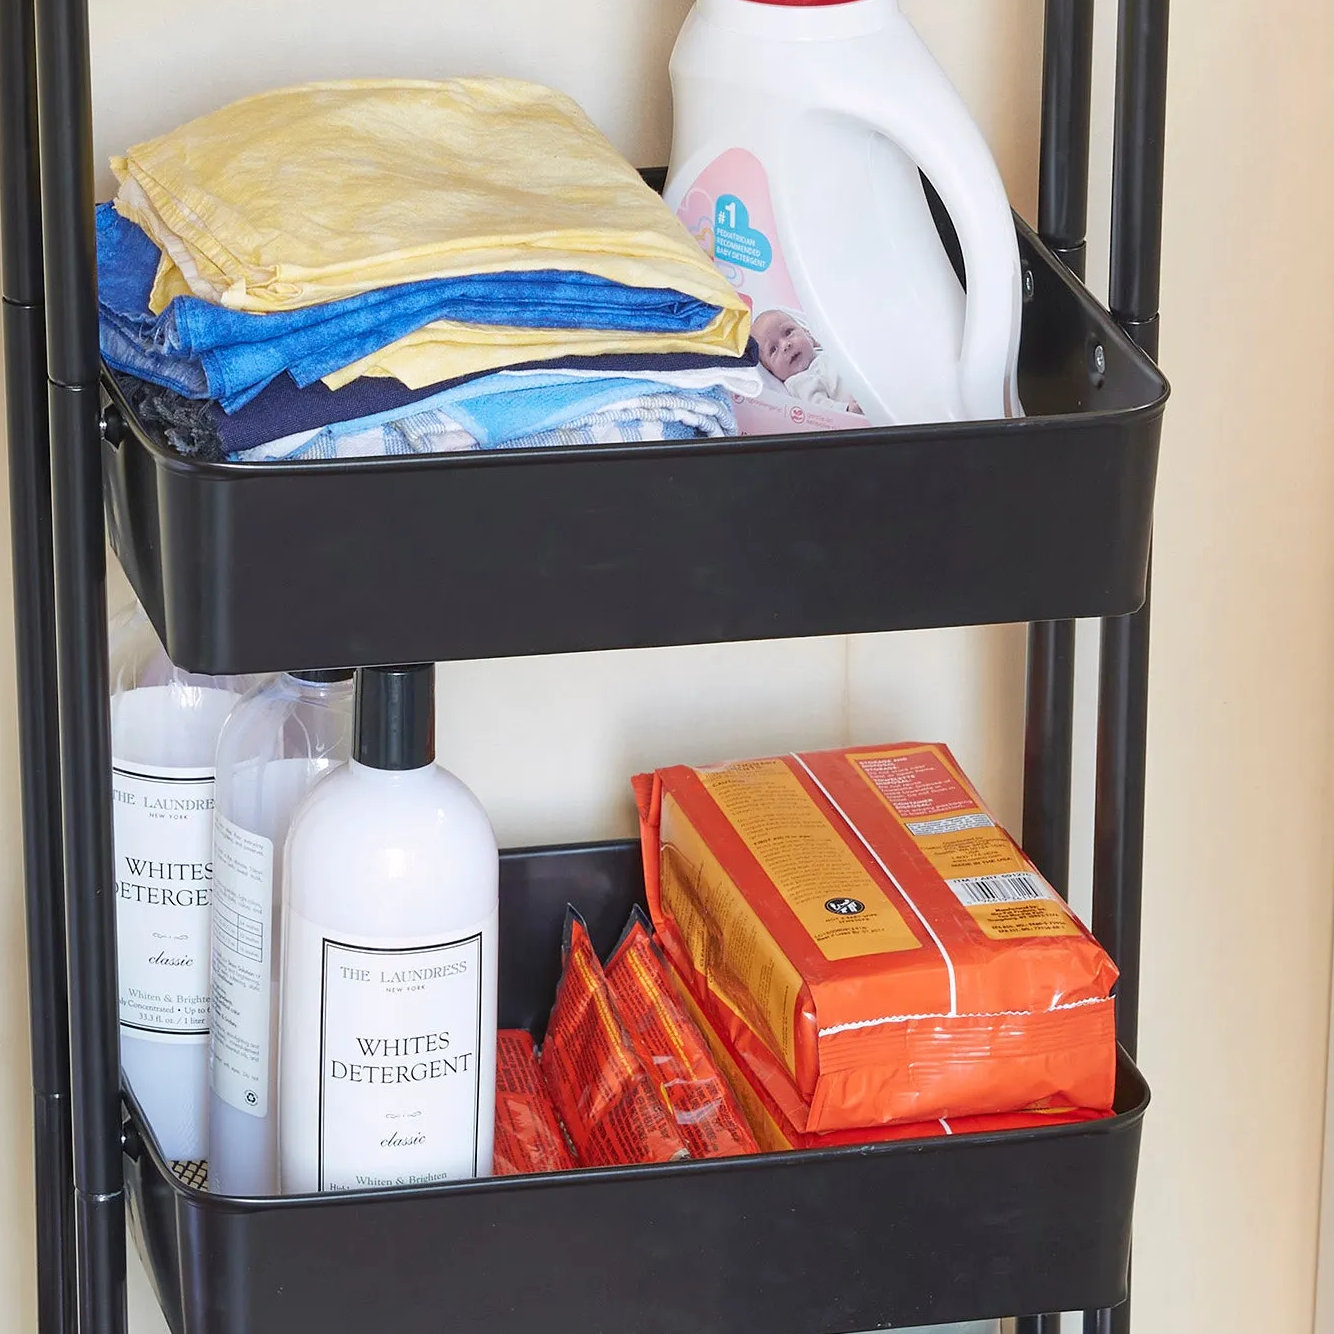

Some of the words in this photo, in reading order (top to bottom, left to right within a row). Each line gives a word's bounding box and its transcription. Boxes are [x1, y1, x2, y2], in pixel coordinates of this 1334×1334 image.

[717, 201, 737, 229] #1
[716, 228, 756, 247] PEDIATRICIAN
[716, 238, 762, 258] RECOMMENDED
[716, 245, 732, 257] BABY
[731, 251, 767, 268] DETERGENT
[113, 788, 136, 806] THE
[144, 796, 215, 811] LAUNDRE
[125, 856, 214, 881] WHITES
[114, 879, 214, 907] ETERGE
[148, 950, 194, 967] classic
[340, 966, 371, 982] THE
[380, 960, 468, 983] LAUNDRESS
[128, 988, 161, 1002] Whiten
[164, 994, 173, 1004] &
[176, 995, 211, 1006] Brighte
[407, 984, 426, 993] YORK
[128, 999, 175, 1014] Concentrated
[184, 1008, 195, 1016] Up
[138, 1012, 154, 1022] 33.3
[356, 1031, 451, 1057] WHITES
[331, 1052, 473, 1084] DETERGENT
[380, 1131, 427, 1148] classic
[355, 1175, 394, 1187] Whiten
[395, 1177, 405, 1186] &
[409, 1171, 447, 1185] Brighten
